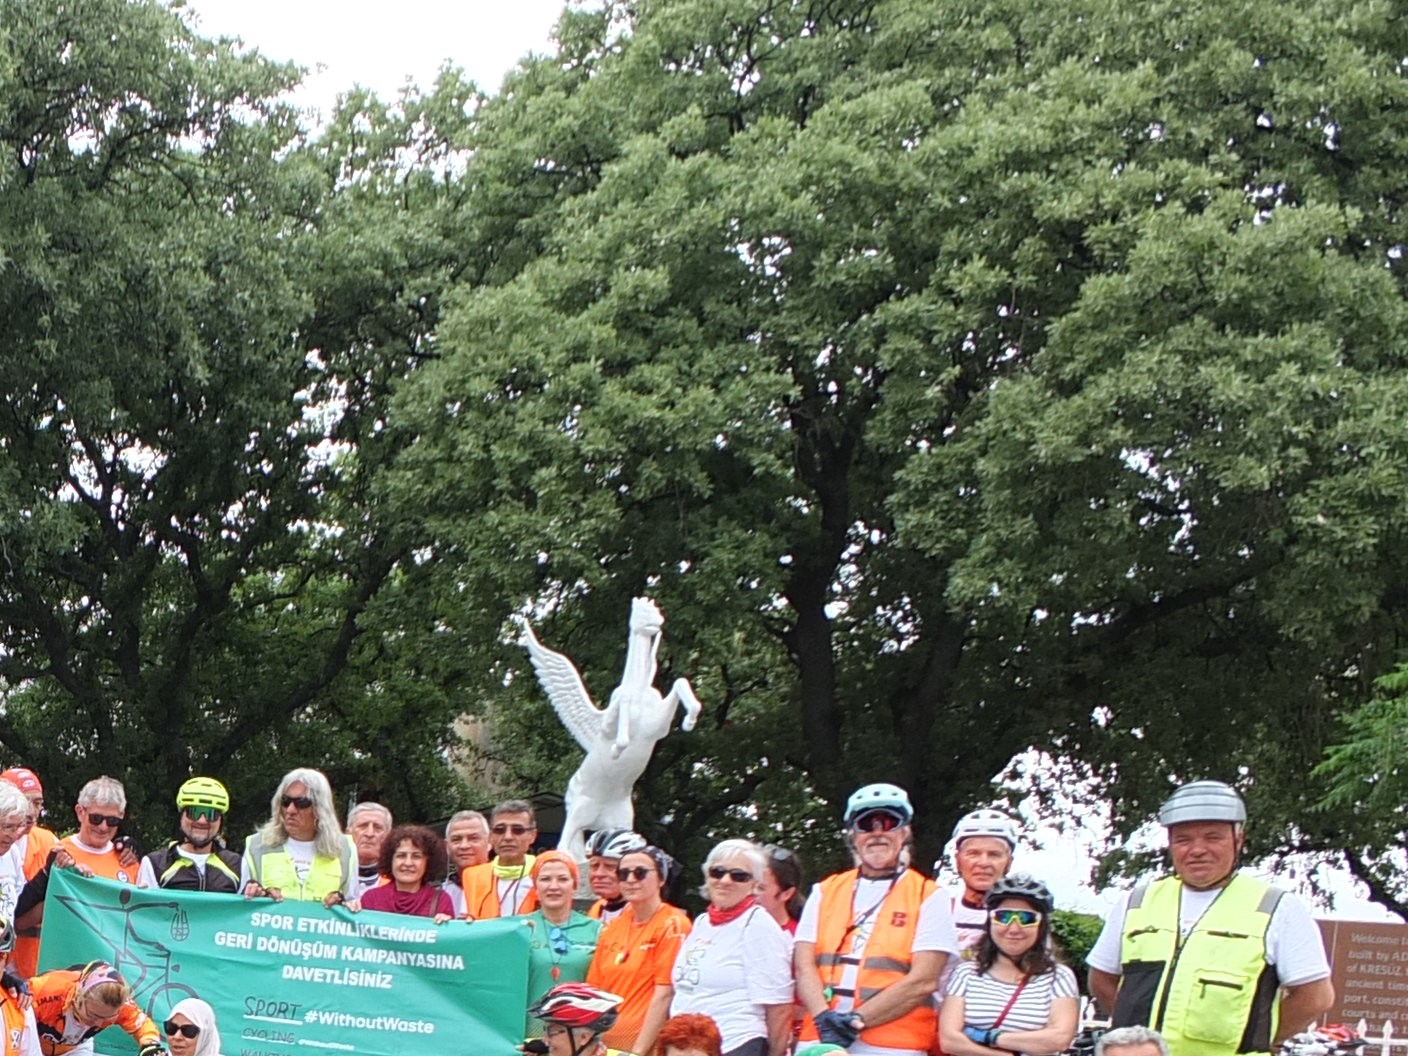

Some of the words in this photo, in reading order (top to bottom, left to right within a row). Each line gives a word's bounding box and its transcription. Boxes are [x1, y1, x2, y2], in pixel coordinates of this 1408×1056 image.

[250, 912, 293, 931] SPOR
[297, 917, 438, 943] ETKİNLİKLERİNDE
[1350, 932, 1400, 945] Welcome
[214, 931, 253, 949] GERİ
[256, 936, 337, 960] DÖNÜŞÜM
[341, 947, 464, 970] KAMPANYASINA
[1348, 949, 1372, 960] built
[1376, 951, 1390, 962] by
[1346, 962, 1359, 973] of
[282, 965, 393, 989] DAVETLİSİNİZ
[1344, 978, 1384, 990] ancient
[244, 996, 302, 1020] SPORT
[304, 1010, 434, 1034] #WithoutWaste
[1378, 1010, 1399, 1020] and
[242, 1027, 295, 1044] CYCLING
